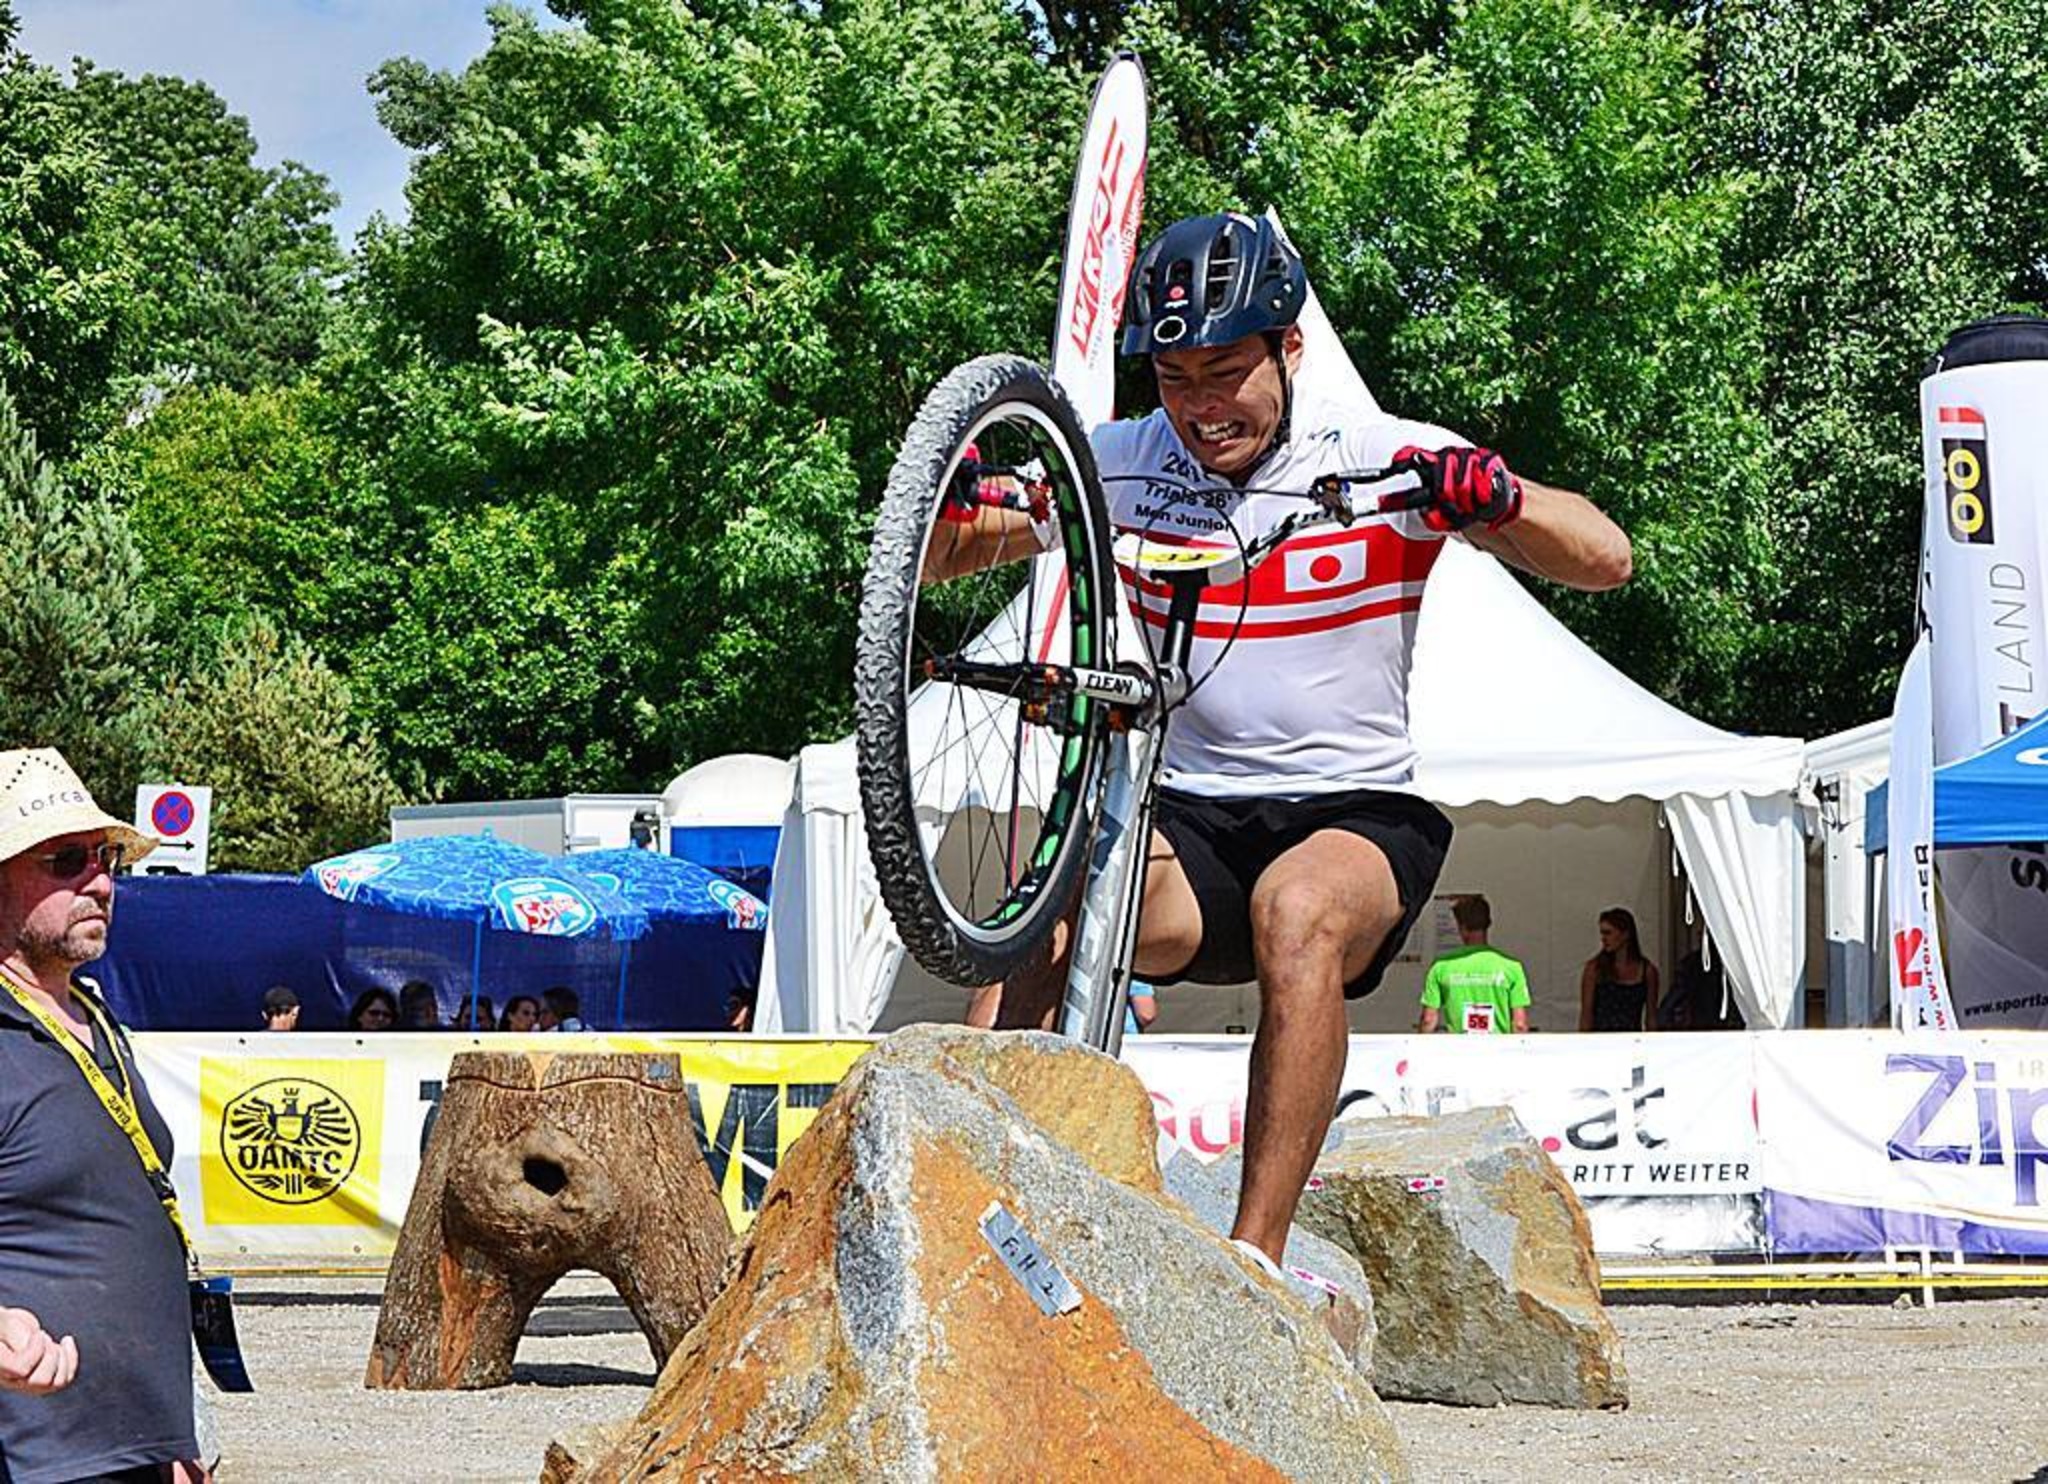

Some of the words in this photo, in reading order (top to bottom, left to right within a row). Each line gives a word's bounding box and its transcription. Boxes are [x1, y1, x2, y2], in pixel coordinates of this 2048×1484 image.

[1161, 451, 1202, 483] 201
[1146, 480, 1199, 506] Trials
[1176, 513, 1230, 532] Junior
[1649, 1163, 1750, 1183] WEITER
